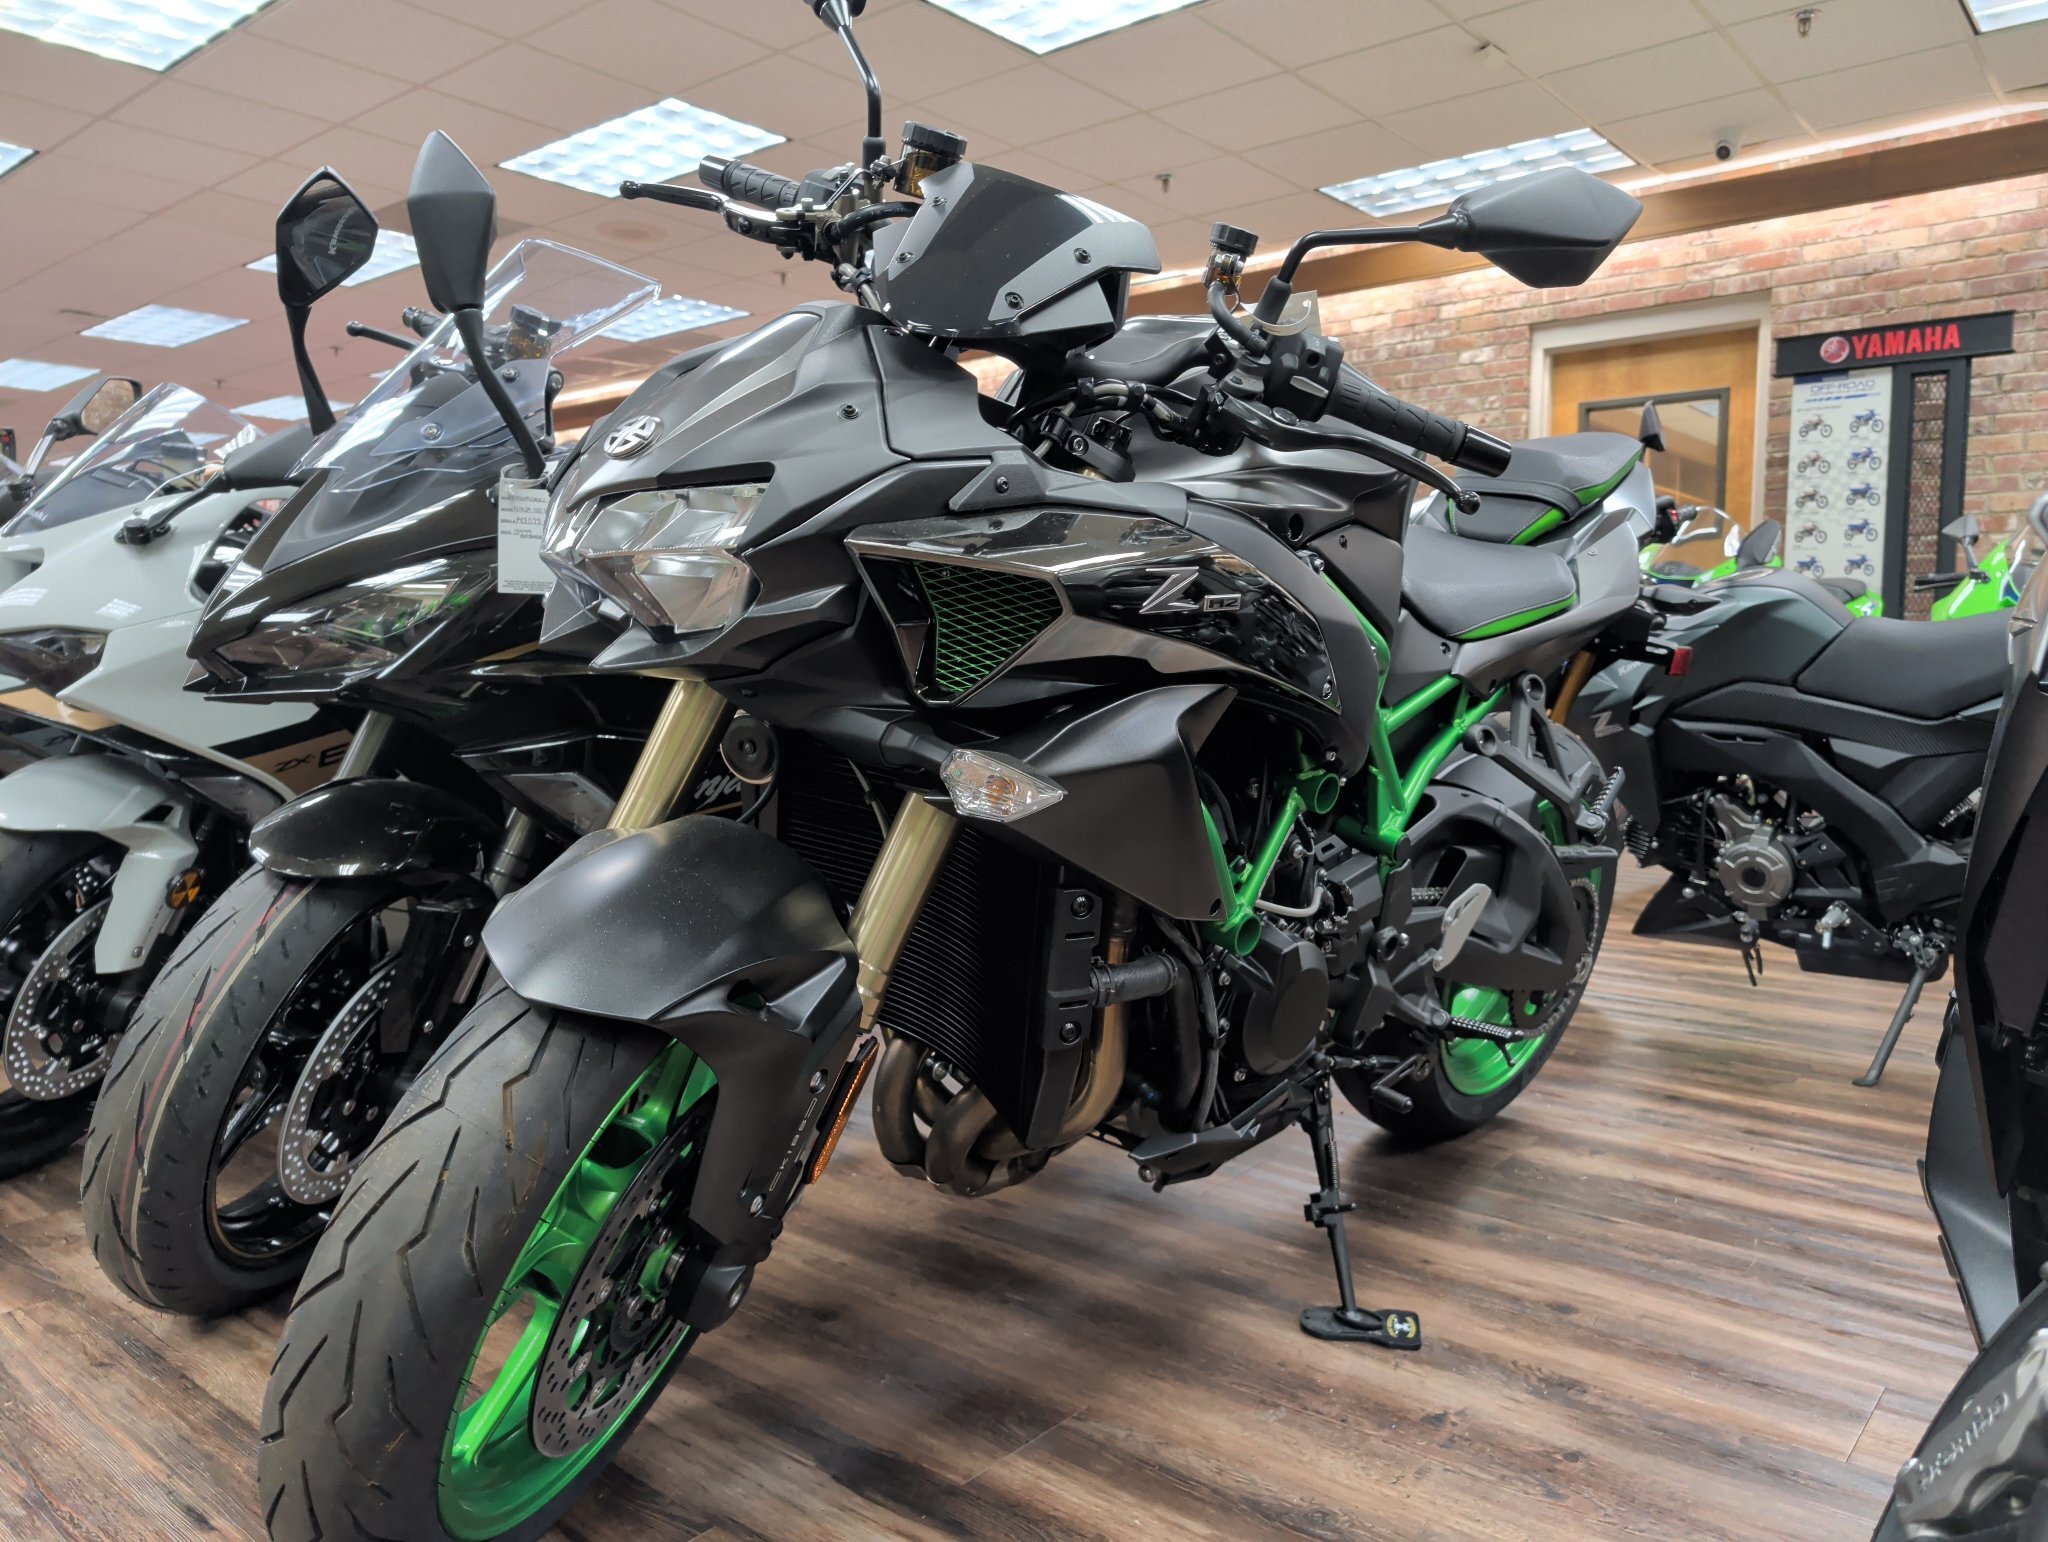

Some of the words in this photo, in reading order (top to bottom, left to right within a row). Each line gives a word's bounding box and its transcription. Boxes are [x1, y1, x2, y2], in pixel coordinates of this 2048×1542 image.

[1852, 323, 1961, 360] YAMAHA
[1139, 566, 1200, 614] Z
[1207, 596, 1240, 610] H2
[1589, 710, 1624, 738] Z
[694, 775, 741, 811] nja
